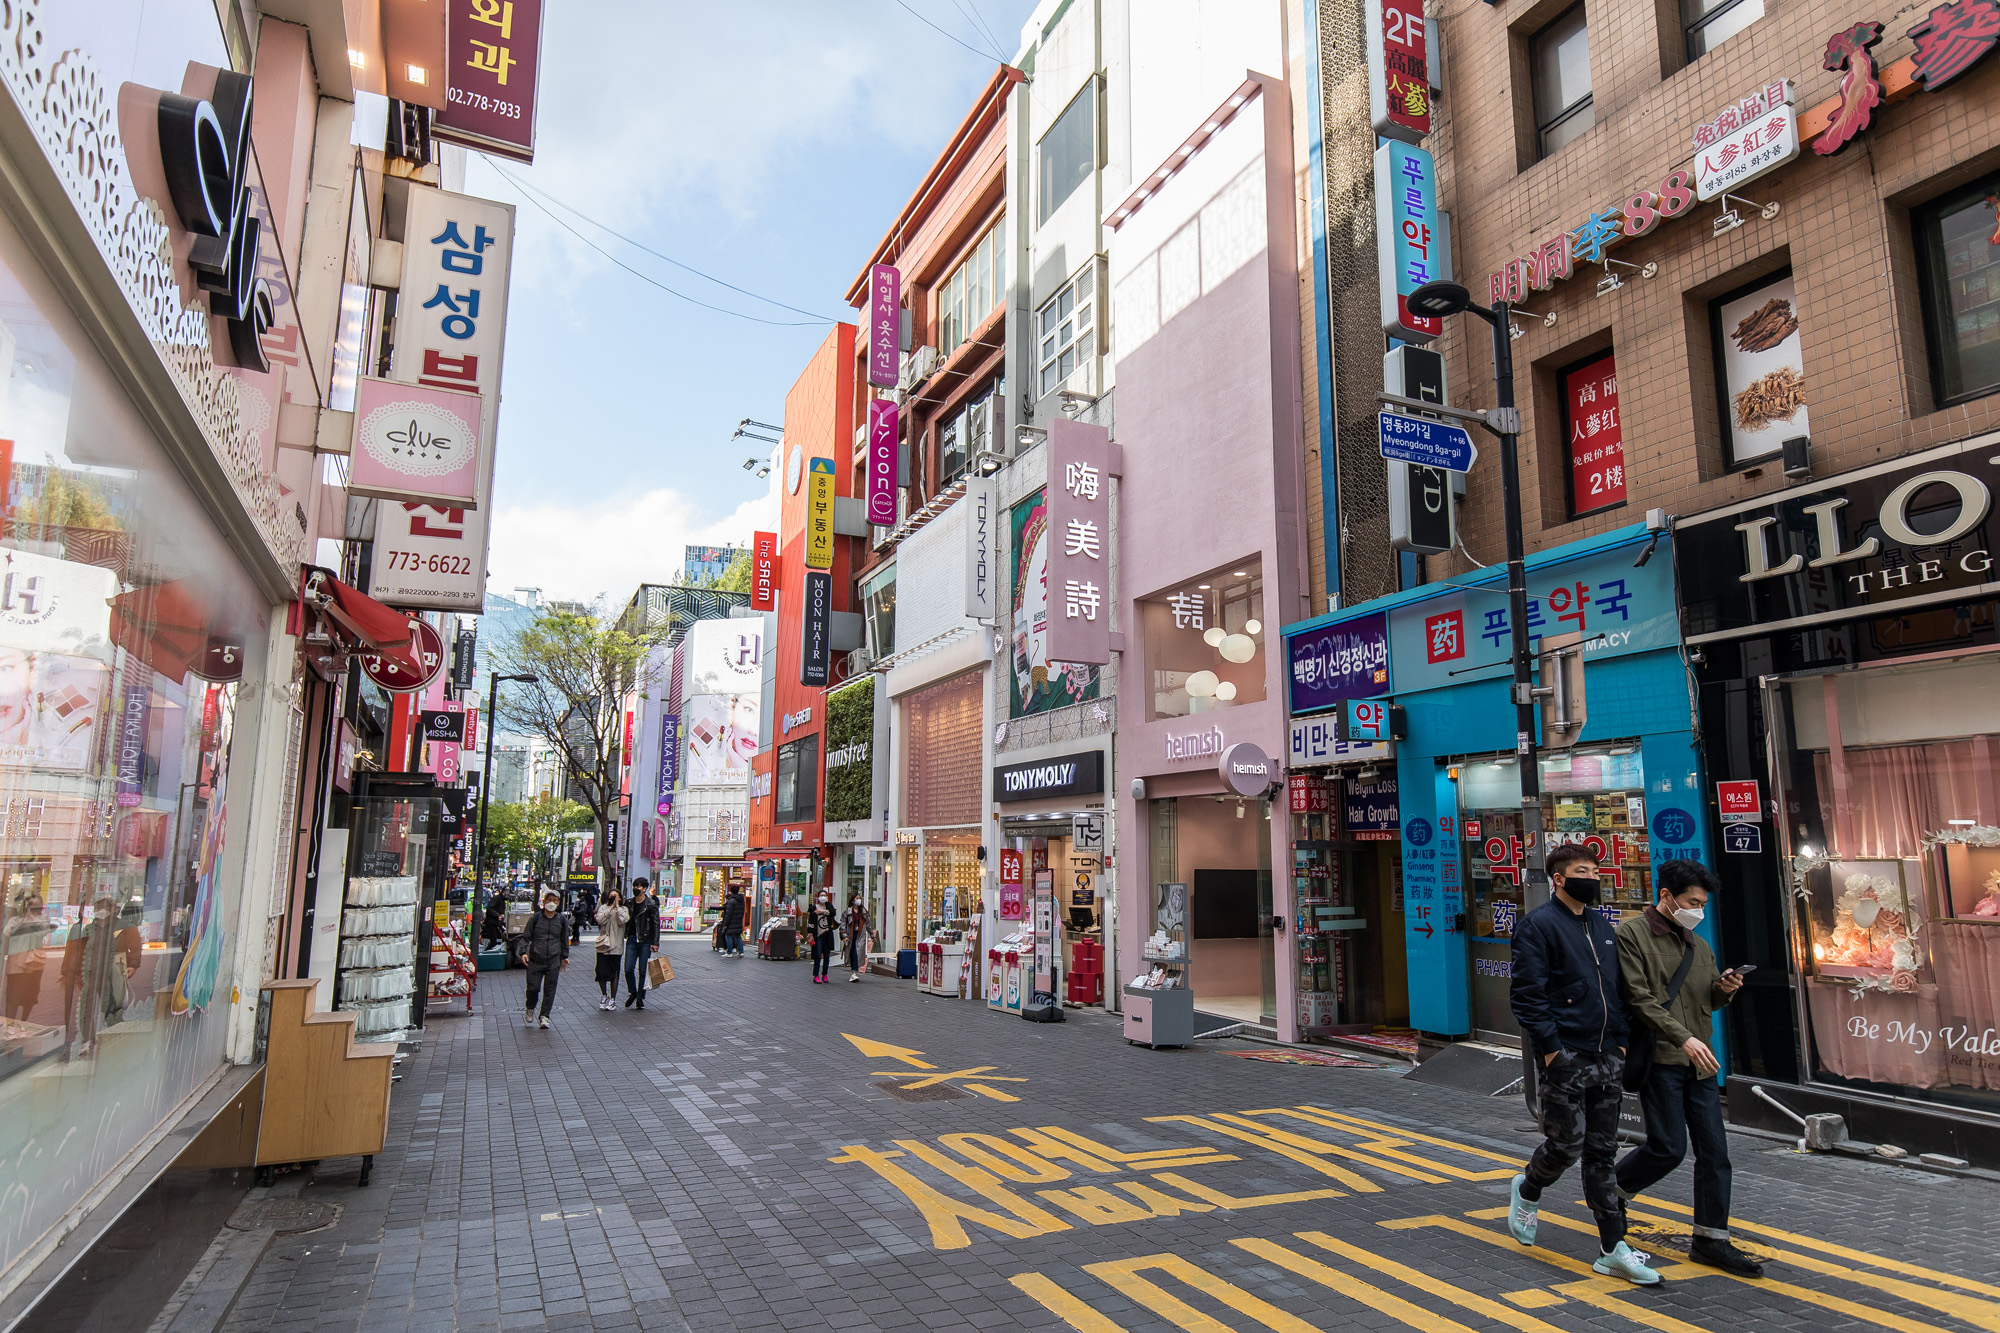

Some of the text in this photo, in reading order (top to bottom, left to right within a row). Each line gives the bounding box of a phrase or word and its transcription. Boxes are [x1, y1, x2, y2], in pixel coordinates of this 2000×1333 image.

[1385, 7, 1423, 47] 2F
[449, 86, 521, 120] 02.778-7933
[1749, 143, 1784, 168] 화장품
[422, 218, 496, 341] 삼성
[876, 320, 894, 369] 옷수선
[1383, 416, 1431, 440] 명동8가길
[1383, 433, 1462, 458] Myeongdong 8ga-gil
[1589, 464, 1623, 496] 2楼
[813, 501, 828, 550] 부동산
[1734, 454, 2000, 583] LLO
[976, 491, 987, 605] TONYMOLY
[1064, 461, 1101, 621] 嗨美詩
[388, 550, 471, 575] 773-6622
[1849, 559, 1943, 596] THE
[758, 559, 771, 602] SAEM
[812, 579, 824, 660] MOON HAIR
[1431, 618, 1459, 656] 药
[1293, 642, 1388, 684] 백명기 신경정신과
[1374, 671, 1387, 683] 3F
[424, 729, 458, 738] MISSHA
[466, 709, 477, 749] Pretty skin
[663, 720, 675, 756] HOLIKA
[1355, 703, 1384, 739] 약
[826, 735, 868, 770] innisfree
[1165, 725, 1224, 760] heimish
[1003, 762, 1074, 792] TONYMOLY
[1232, 761, 1268, 776] heimish
[466, 785, 478, 810] FILA
[1348, 803, 1398, 823] Hair Growth
[1726, 792, 1752, 804] 에스원
[1439, 815, 1455, 837] 약
[1735, 837, 1750, 849] 47
[463, 832, 473, 863] swatch
[1484, 834, 1524, 886] 약
[1406, 874, 1437, 888] Pharmacy
[1407, 861, 1435, 875] Ginseng
[1002, 901, 1021, 916] 50
[1415, 905, 1432, 920] 1F
[1491, 899, 1518, 934] 药
[1847, 1015, 1880, 1039] Be
[1886, 1020, 1932, 1055] My
[1950, 1054, 1995, 1070] Red Tie
